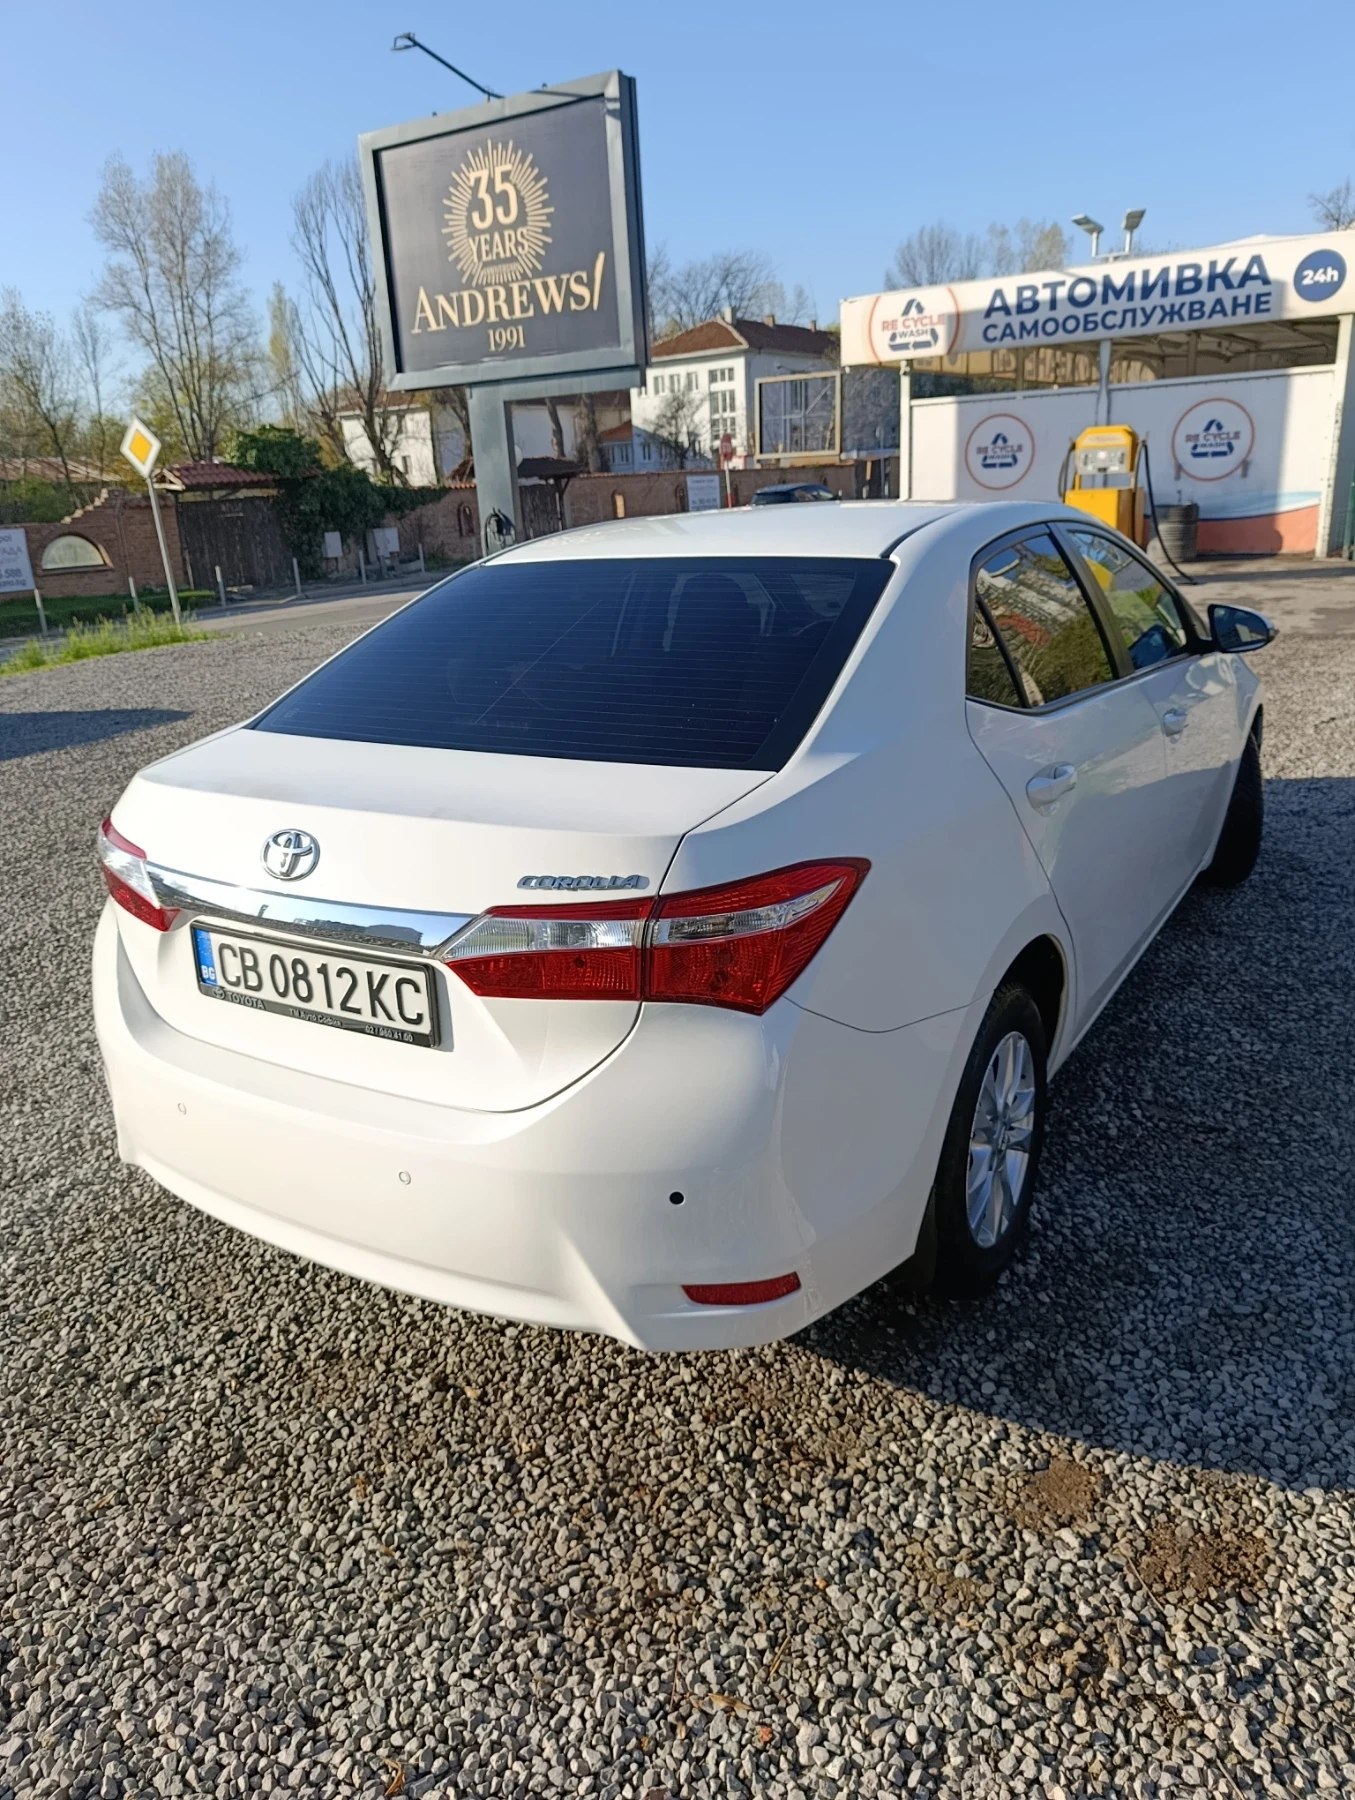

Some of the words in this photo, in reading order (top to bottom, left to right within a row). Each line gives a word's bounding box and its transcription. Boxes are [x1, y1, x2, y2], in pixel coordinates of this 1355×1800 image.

[469, 163, 518, 230] 35
[469, 227, 529, 264] YEARS
[1301, 266, 1339, 286] 24h
[984, 254, 1272, 319] АВТОМИВКА
[882, 319, 898, 332] RE
[902, 314, 945, 328] CYCLE
[982, 292, 1272, 343] САМООБСЛУЖВАНЕ
[488, 325, 526, 352] 1991
[898, 329, 928, 339] WASH
[517, 875, 650, 891] COROLLA
[201, 965, 216, 981] BG
[226, 991, 265, 1010] TOYOTA
